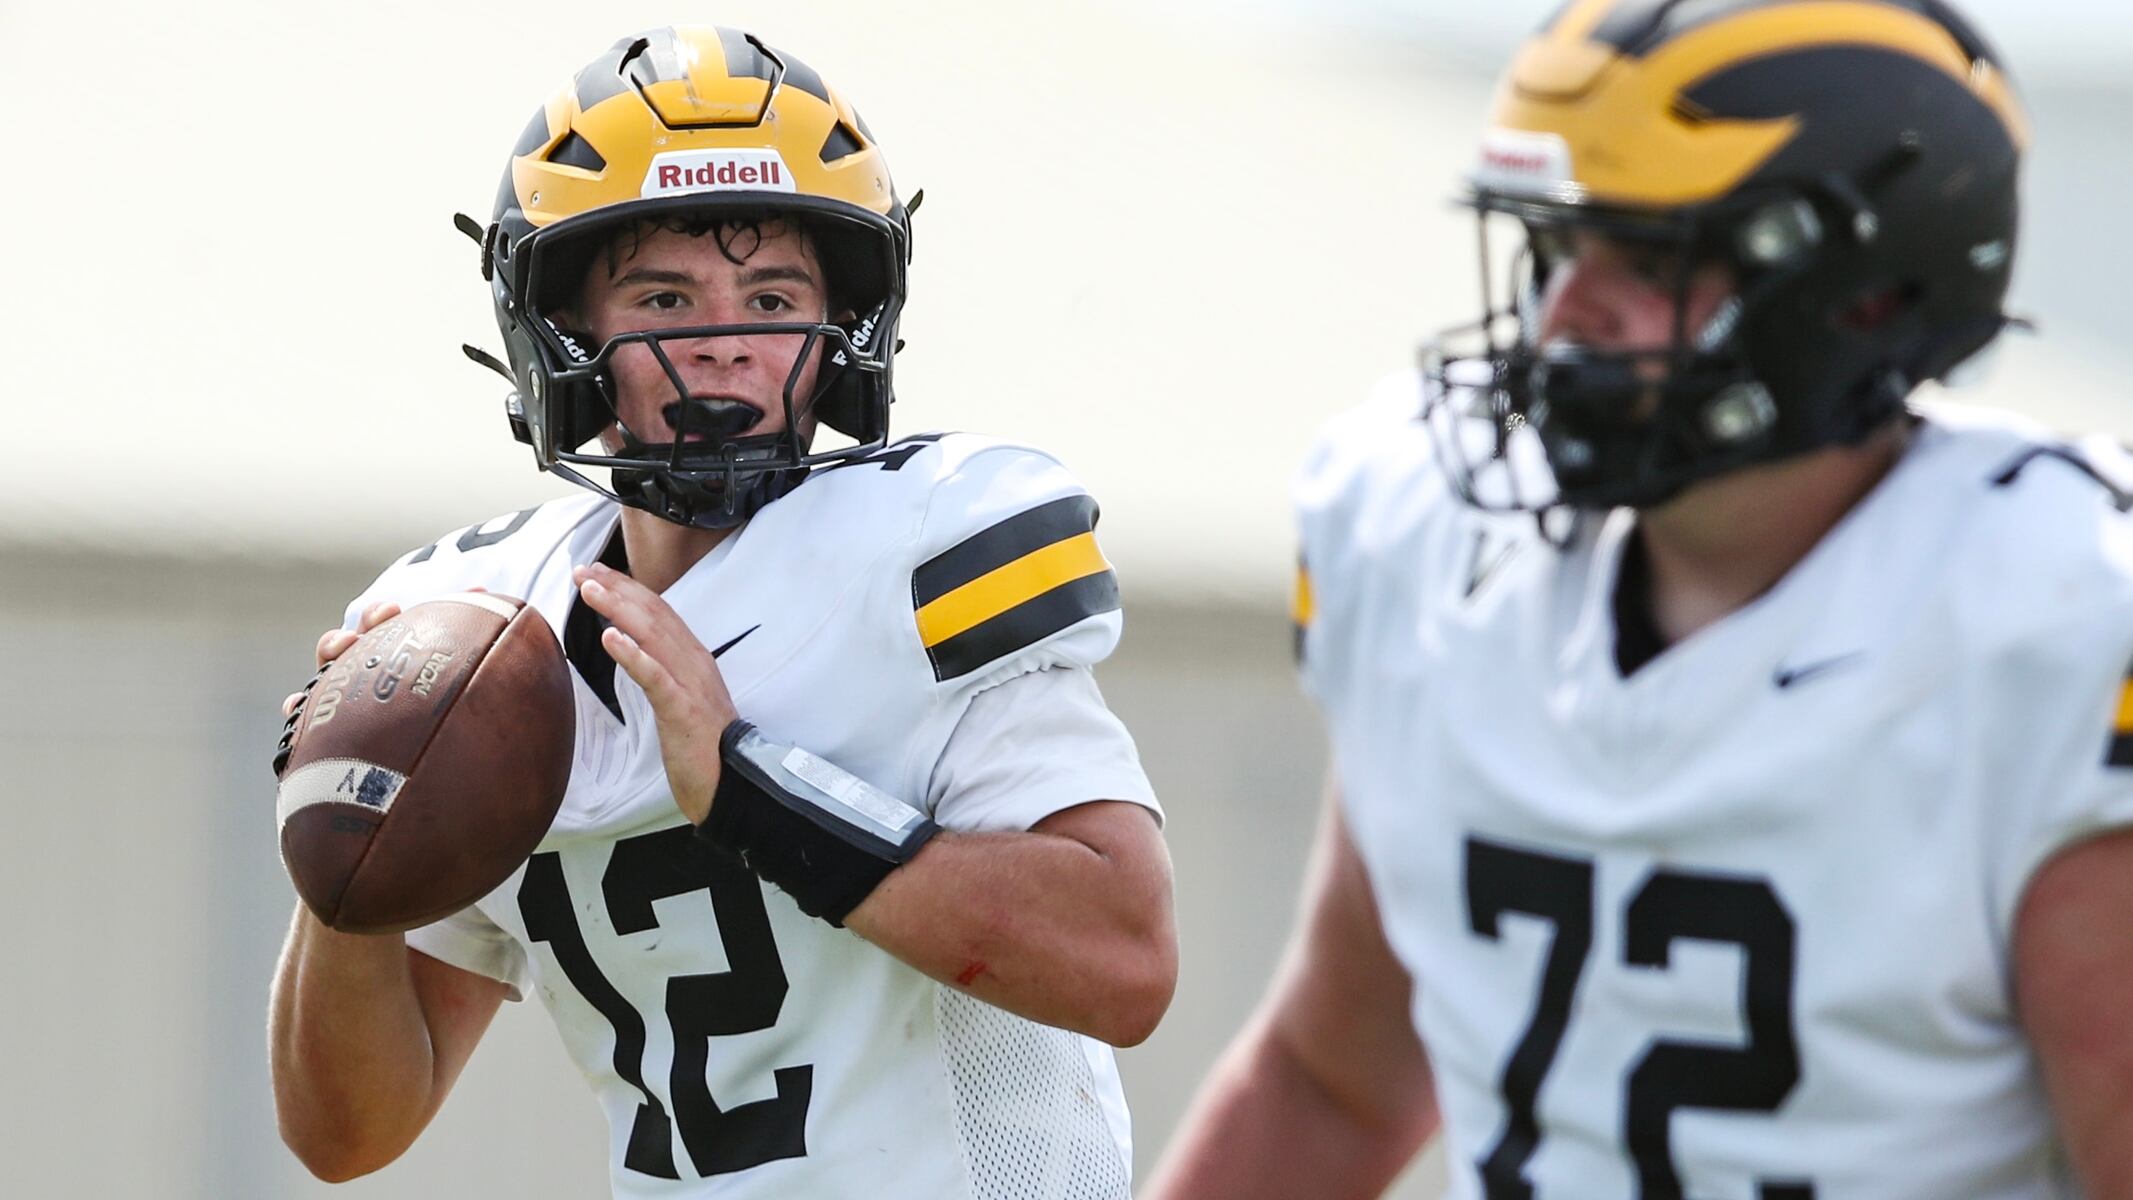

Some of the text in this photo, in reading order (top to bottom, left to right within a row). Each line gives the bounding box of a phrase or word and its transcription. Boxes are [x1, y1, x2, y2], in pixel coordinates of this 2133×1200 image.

[658, 161, 780, 188] Riddell
[411, 651, 455, 696] NCAA
[517, 823, 814, 1180] 12
[1461, 836, 1816, 1200] 72
